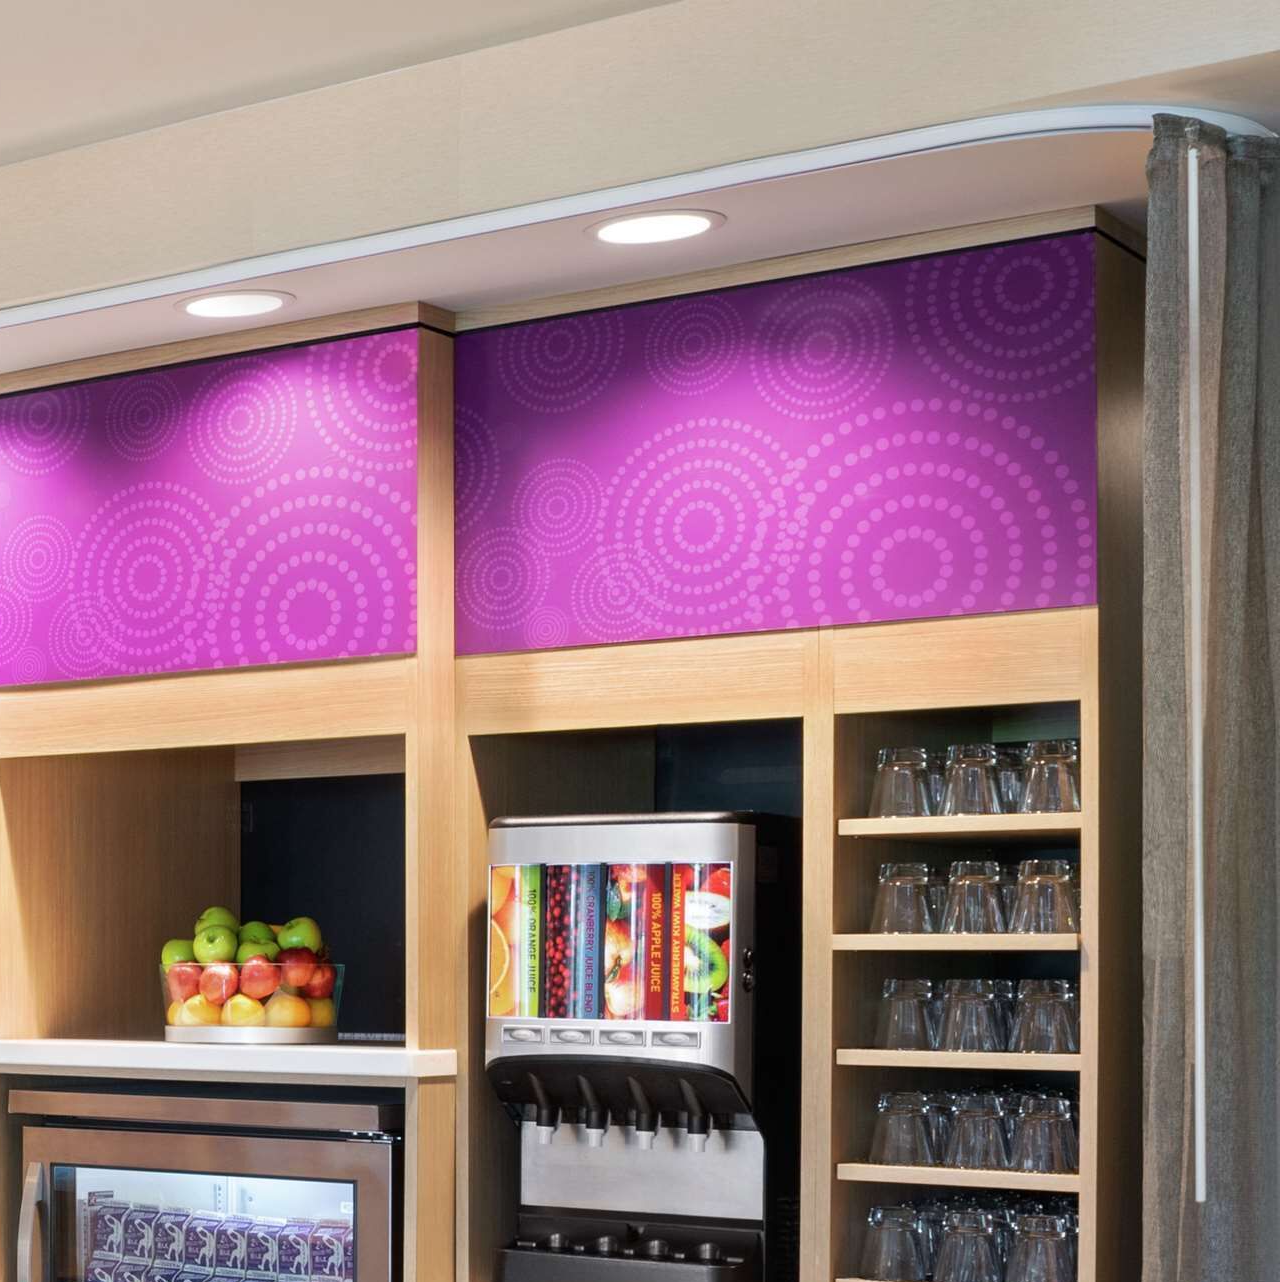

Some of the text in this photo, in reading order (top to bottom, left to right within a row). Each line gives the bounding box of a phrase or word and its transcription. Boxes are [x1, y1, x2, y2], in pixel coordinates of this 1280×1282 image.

[527, 888, 537, 993] 100% ORANGE JUICE
[586, 895, 595, 952] CRANBERRY
[650, 892, 662, 993] 100% APPLE JUICE
[671, 873, 682, 1013] STRAWBERRY KIWI WATER
[584, 983, 594, 1013] BLEND
[585, 955, 594, 980] JUICE
